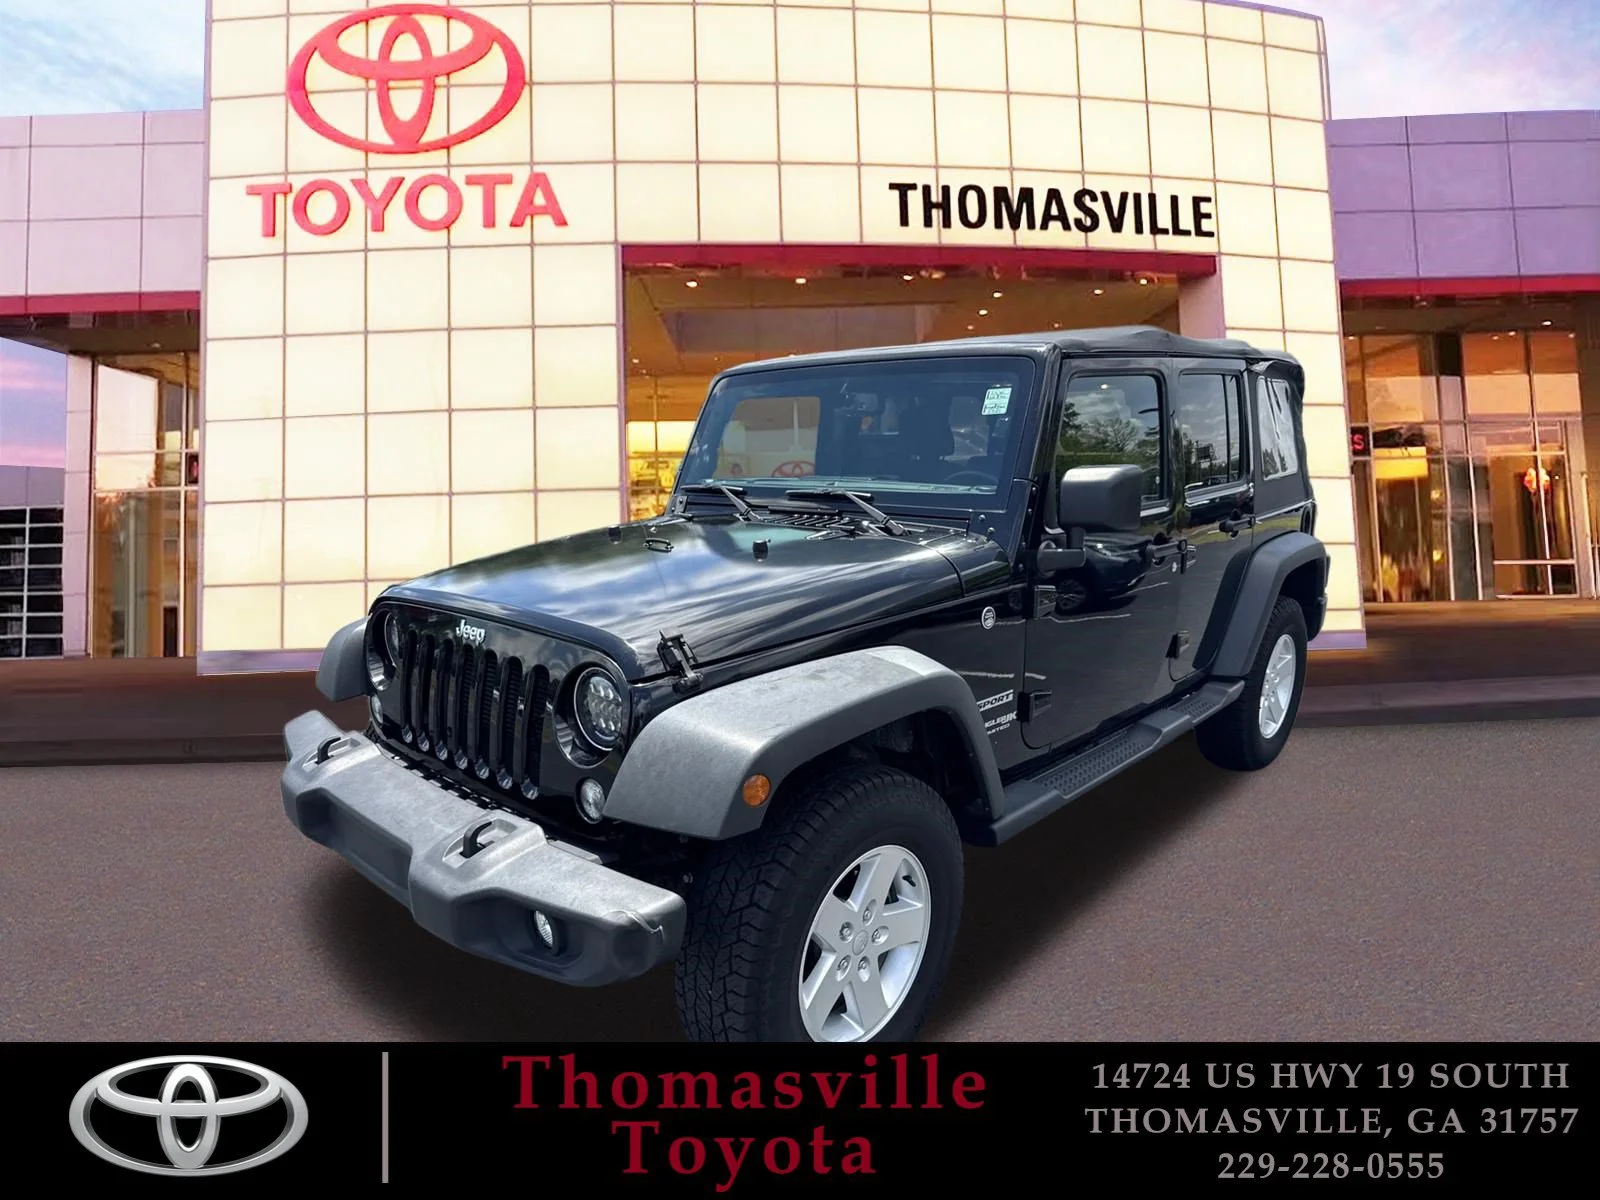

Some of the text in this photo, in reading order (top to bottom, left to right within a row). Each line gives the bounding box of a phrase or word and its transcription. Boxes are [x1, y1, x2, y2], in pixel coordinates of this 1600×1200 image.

[247, 172, 568, 238] TOYOTA
[889, 183, 1215, 238] THOMASVILLE
[455, 619, 486, 646] Jeep
[977, 691, 1014, 711] SPORT
